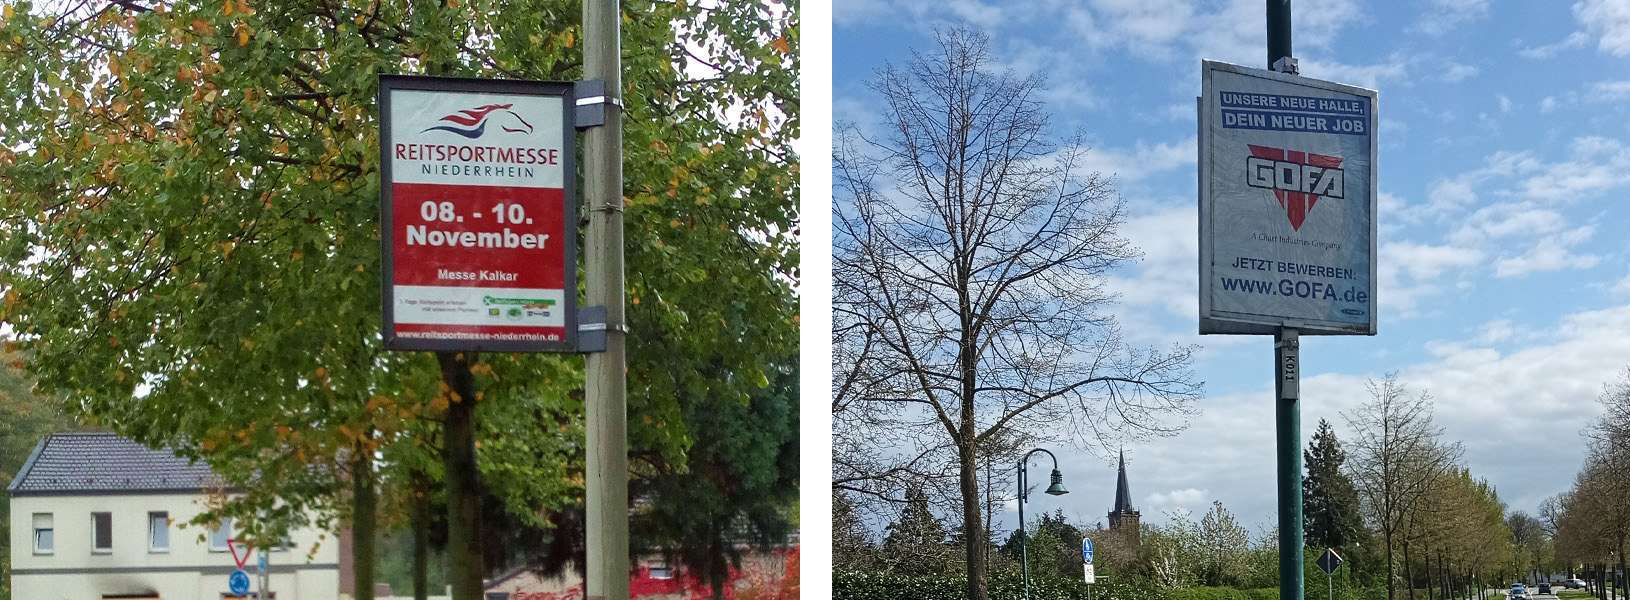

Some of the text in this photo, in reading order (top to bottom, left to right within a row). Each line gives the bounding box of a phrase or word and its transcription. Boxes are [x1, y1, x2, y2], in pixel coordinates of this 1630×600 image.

[1222, 93, 1364, 114] UNSERE NEUE HALLE,
[1225, 112, 1364, 133] DEIN NEUER JOB
[396, 143, 559, 165] REITSPORTMESSE
[422, 164, 534, 178] NIEDERRHEIN
[1246, 155, 1345, 200] GOFA
[420, 201, 464, 223] 08.
[491, 203, 533, 225] 10.
[406, 225, 549, 249] November
[1251, 232, 1342, 251] A Chart Industries Company
[437, 269, 518, 282] Messe Kalkar
[1232, 256, 1357, 280] JETZT BEWERBEN:
[1221, 277, 1368, 304] www.GOFA.de
[395, 331, 560, 341] www.reitsportmesse-niederrhein.de
